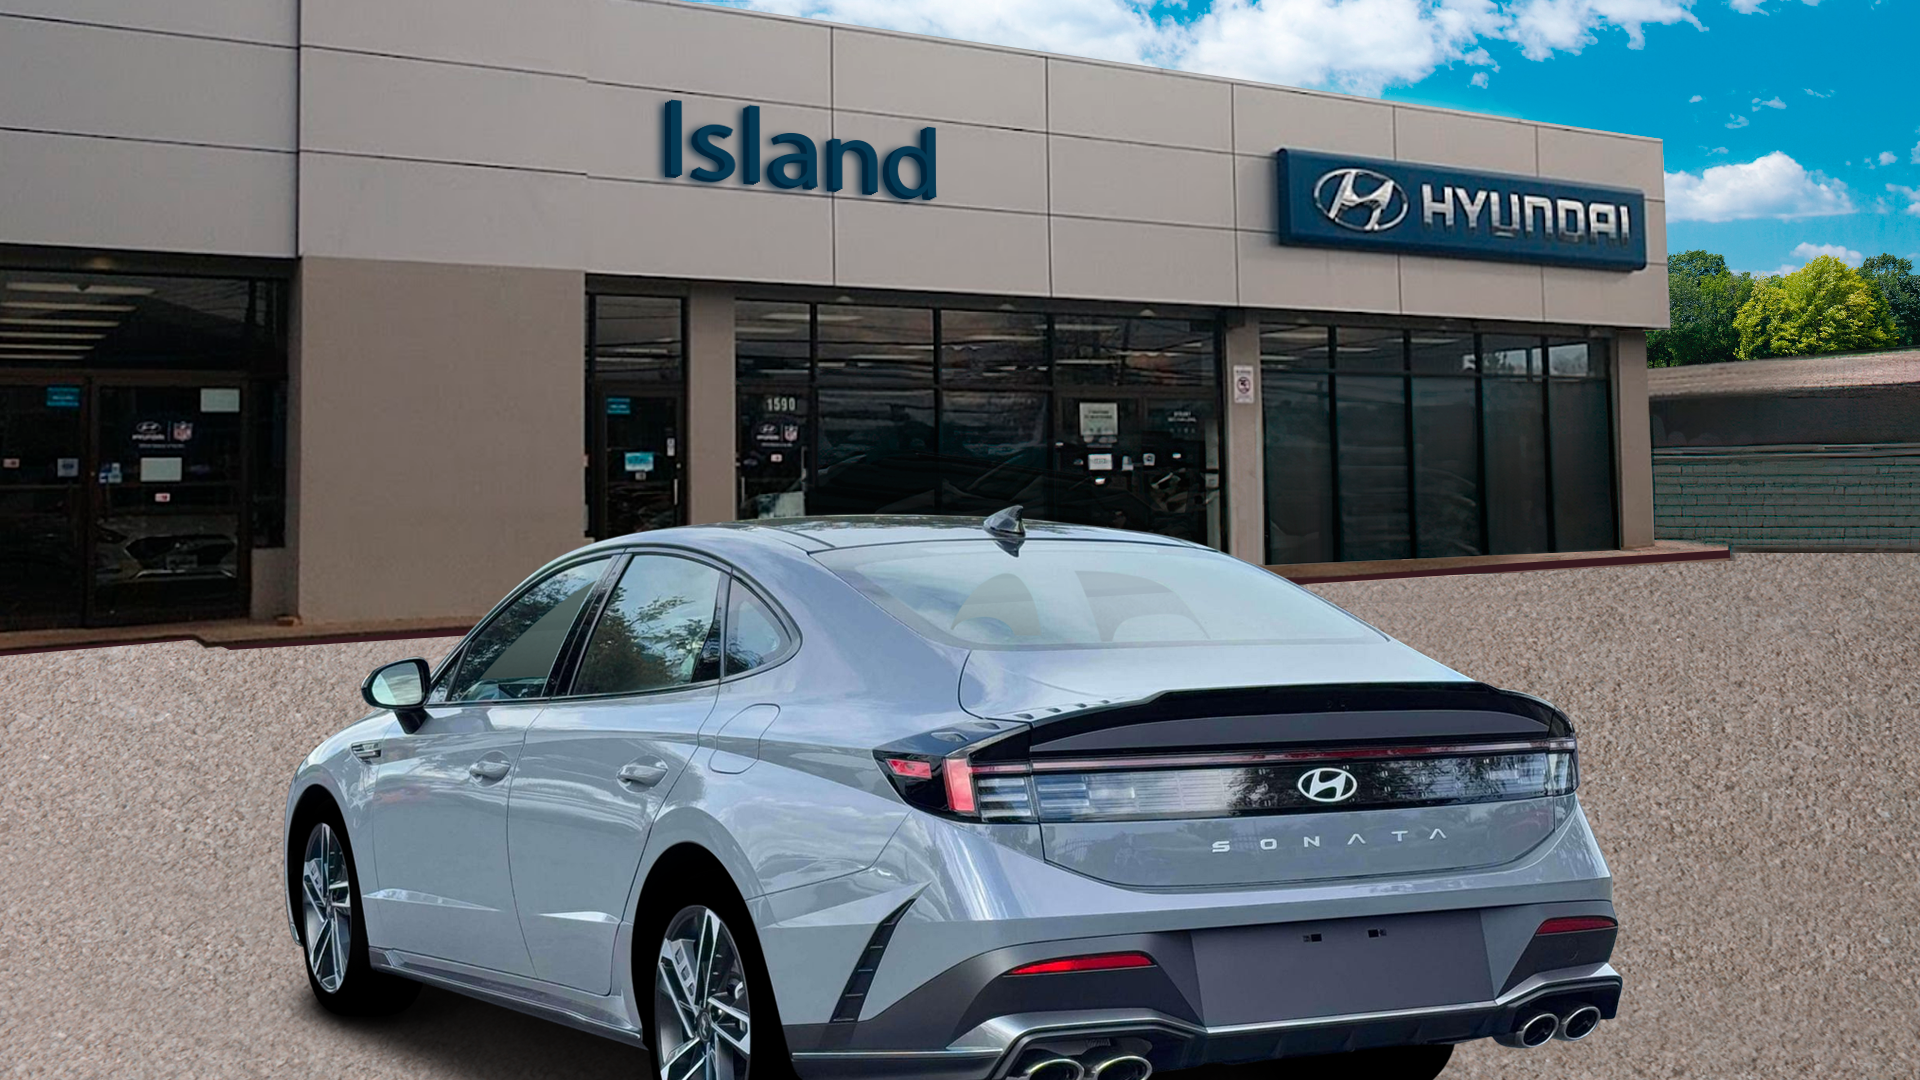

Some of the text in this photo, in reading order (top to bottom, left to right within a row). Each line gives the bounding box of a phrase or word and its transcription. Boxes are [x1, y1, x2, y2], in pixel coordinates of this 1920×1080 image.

[664, 99, 937, 201] Island
[1421, 183, 1630, 245] HYUNDAI
[766, 397, 796, 411] 1590
[1211, 828, 1447, 853] SONATA
